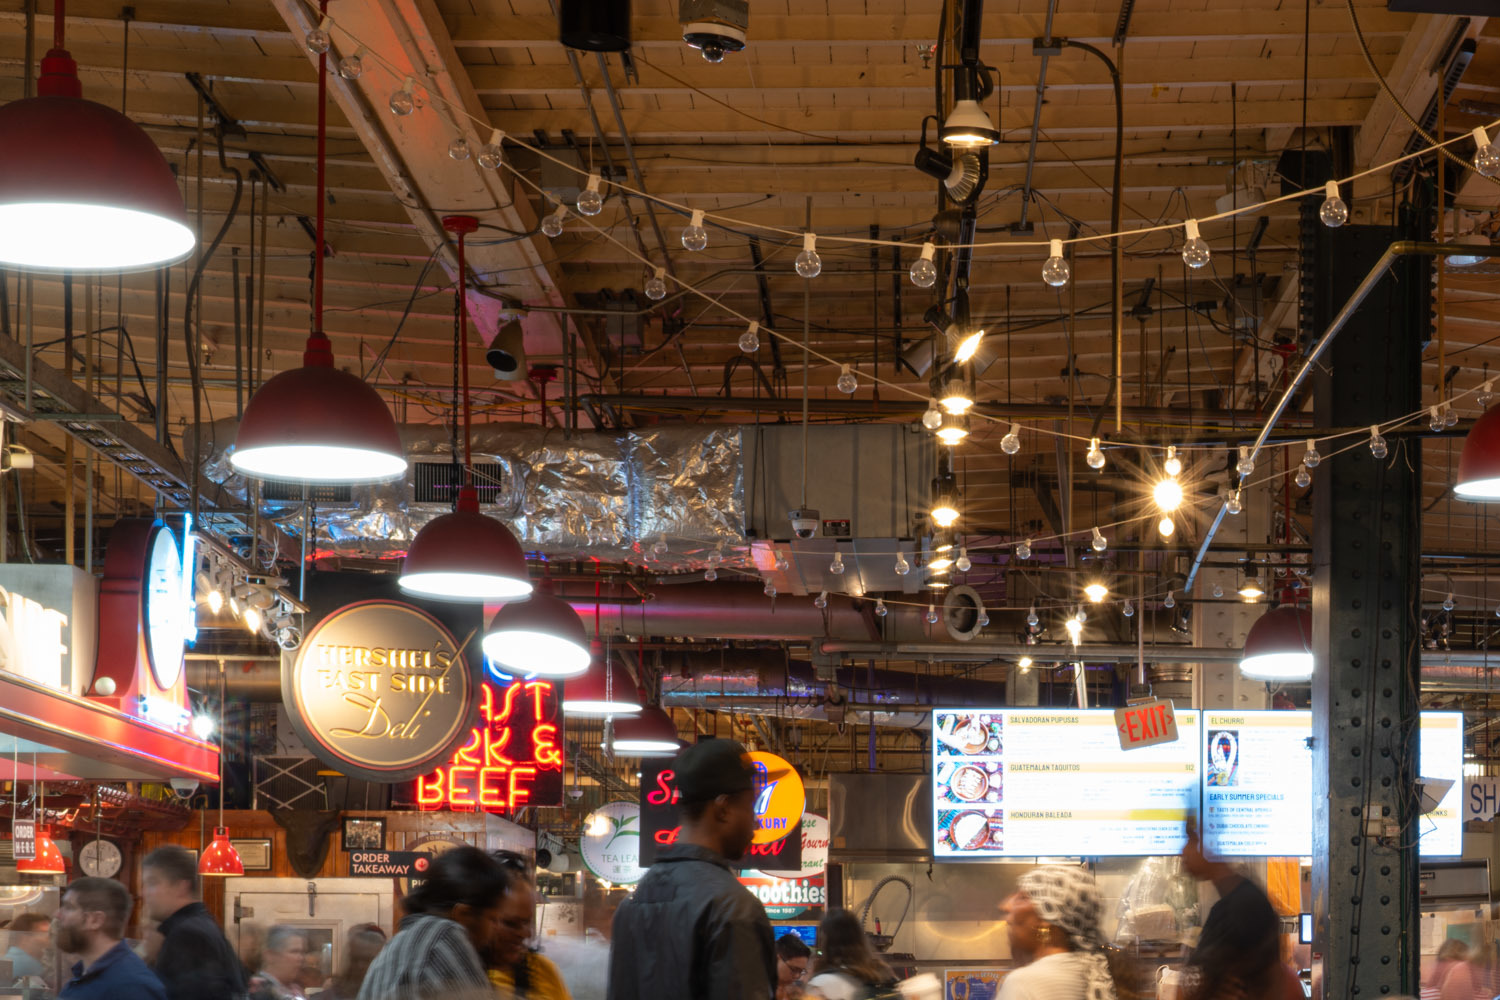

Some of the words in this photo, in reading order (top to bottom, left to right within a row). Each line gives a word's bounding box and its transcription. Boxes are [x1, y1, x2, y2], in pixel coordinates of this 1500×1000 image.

[316, 641, 450, 670] HERSHEL'S
[316, 669, 381, 693] EAST
[391, 672, 450, 695] SIDE
[329, 690, 433, 740] Deli
[1010, 716, 1050, 724] SALVADORAN
[1051, 716, 1080, 724] PUPUSAS
[1211, 717, 1218, 725] EL
[1219, 717, 1245, 725] CHURRO
[1124, 704, 1168, 743] EXIT
[455, 727, 513, 766] RK
[531, 724, 562, 766] &
[417, 763, 536, 808] BEEF
[1210, 793, 1228, 801] EARLY
[1229, 793, 1255, 801] SUMMER
[1256, 793, 1284, 801] SPECIALS
[1010, 811, 1044, 819] HONDURAN
[15, 825, 34, 839] ORDER
[352, 852, 390, 863] ORDER
[602, 854, 619, 864] TEA
[621, 854, 638, 864] LEA
[352, 864, 410, 875] TAKEAWAY
